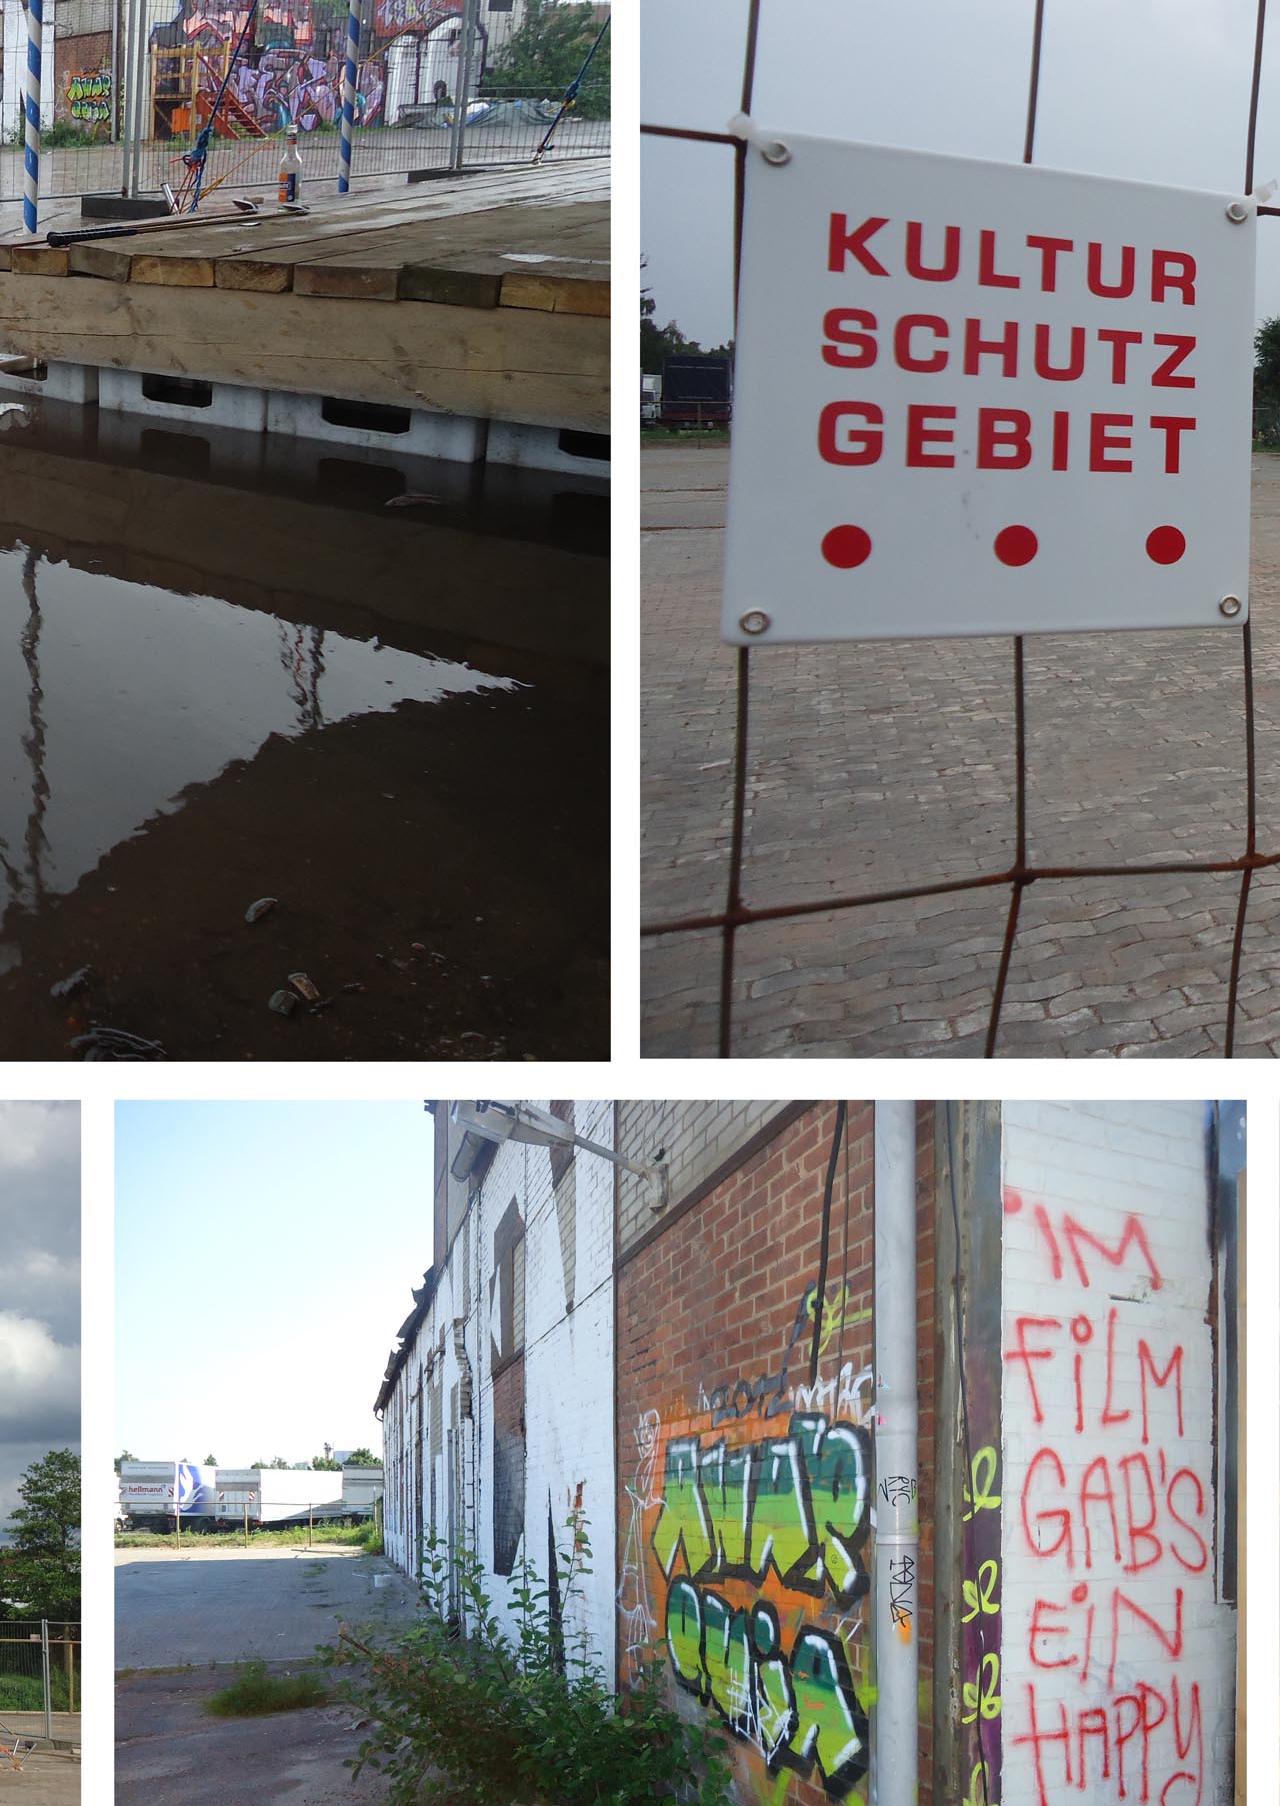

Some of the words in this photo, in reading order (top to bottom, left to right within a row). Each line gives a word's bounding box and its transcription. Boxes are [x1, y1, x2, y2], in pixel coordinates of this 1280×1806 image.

[827, 212, 1197, 305] KULTUR
[821, 308, 1197, 389] SCHUTZ
[817, 400, 1197, 474] GEBIET
